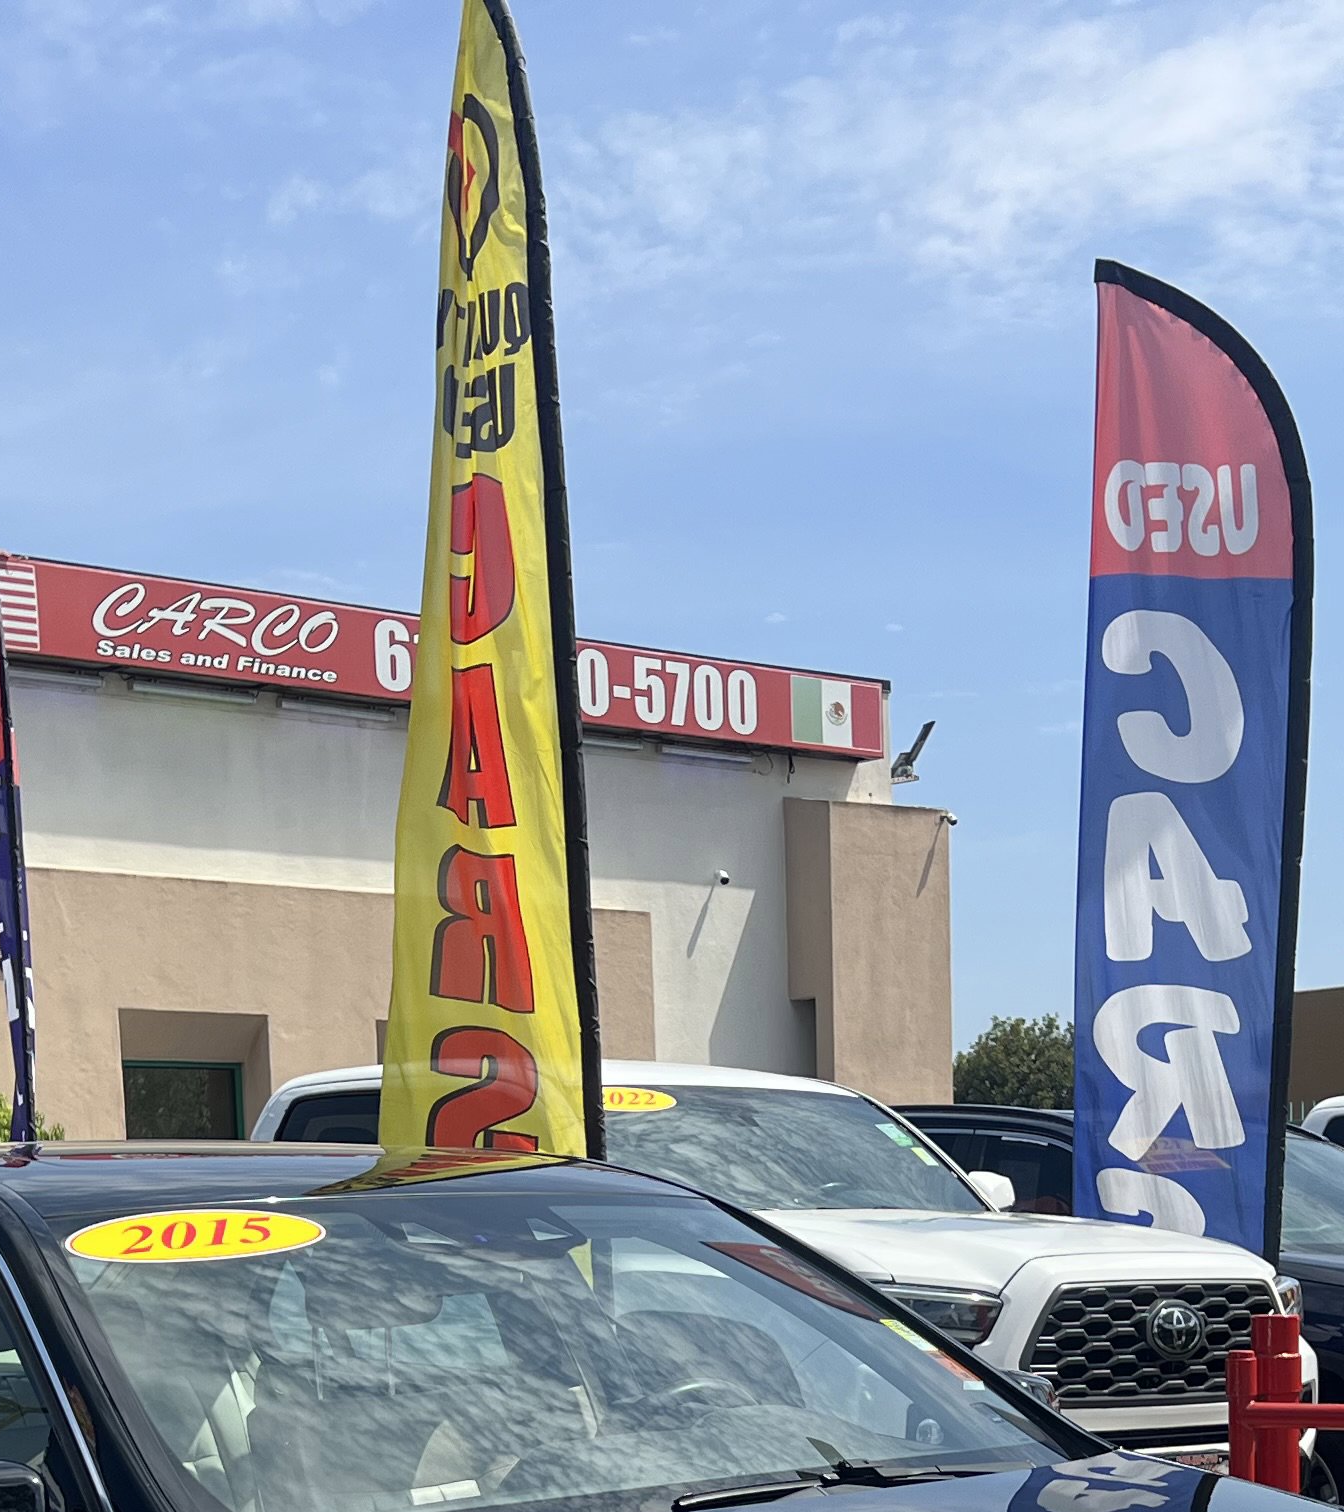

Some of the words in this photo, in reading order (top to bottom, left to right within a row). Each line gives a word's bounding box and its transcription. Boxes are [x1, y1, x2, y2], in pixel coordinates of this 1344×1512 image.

[91, 582, 340, 656] CARCO
[96, 639, 172, 664] Sales
[180, 649, 230, 671] and
[237, 656, 339, 684] Finance
[602, 1091, 657, 1106] 022
[120, 1216, 272, 1256] 2015
